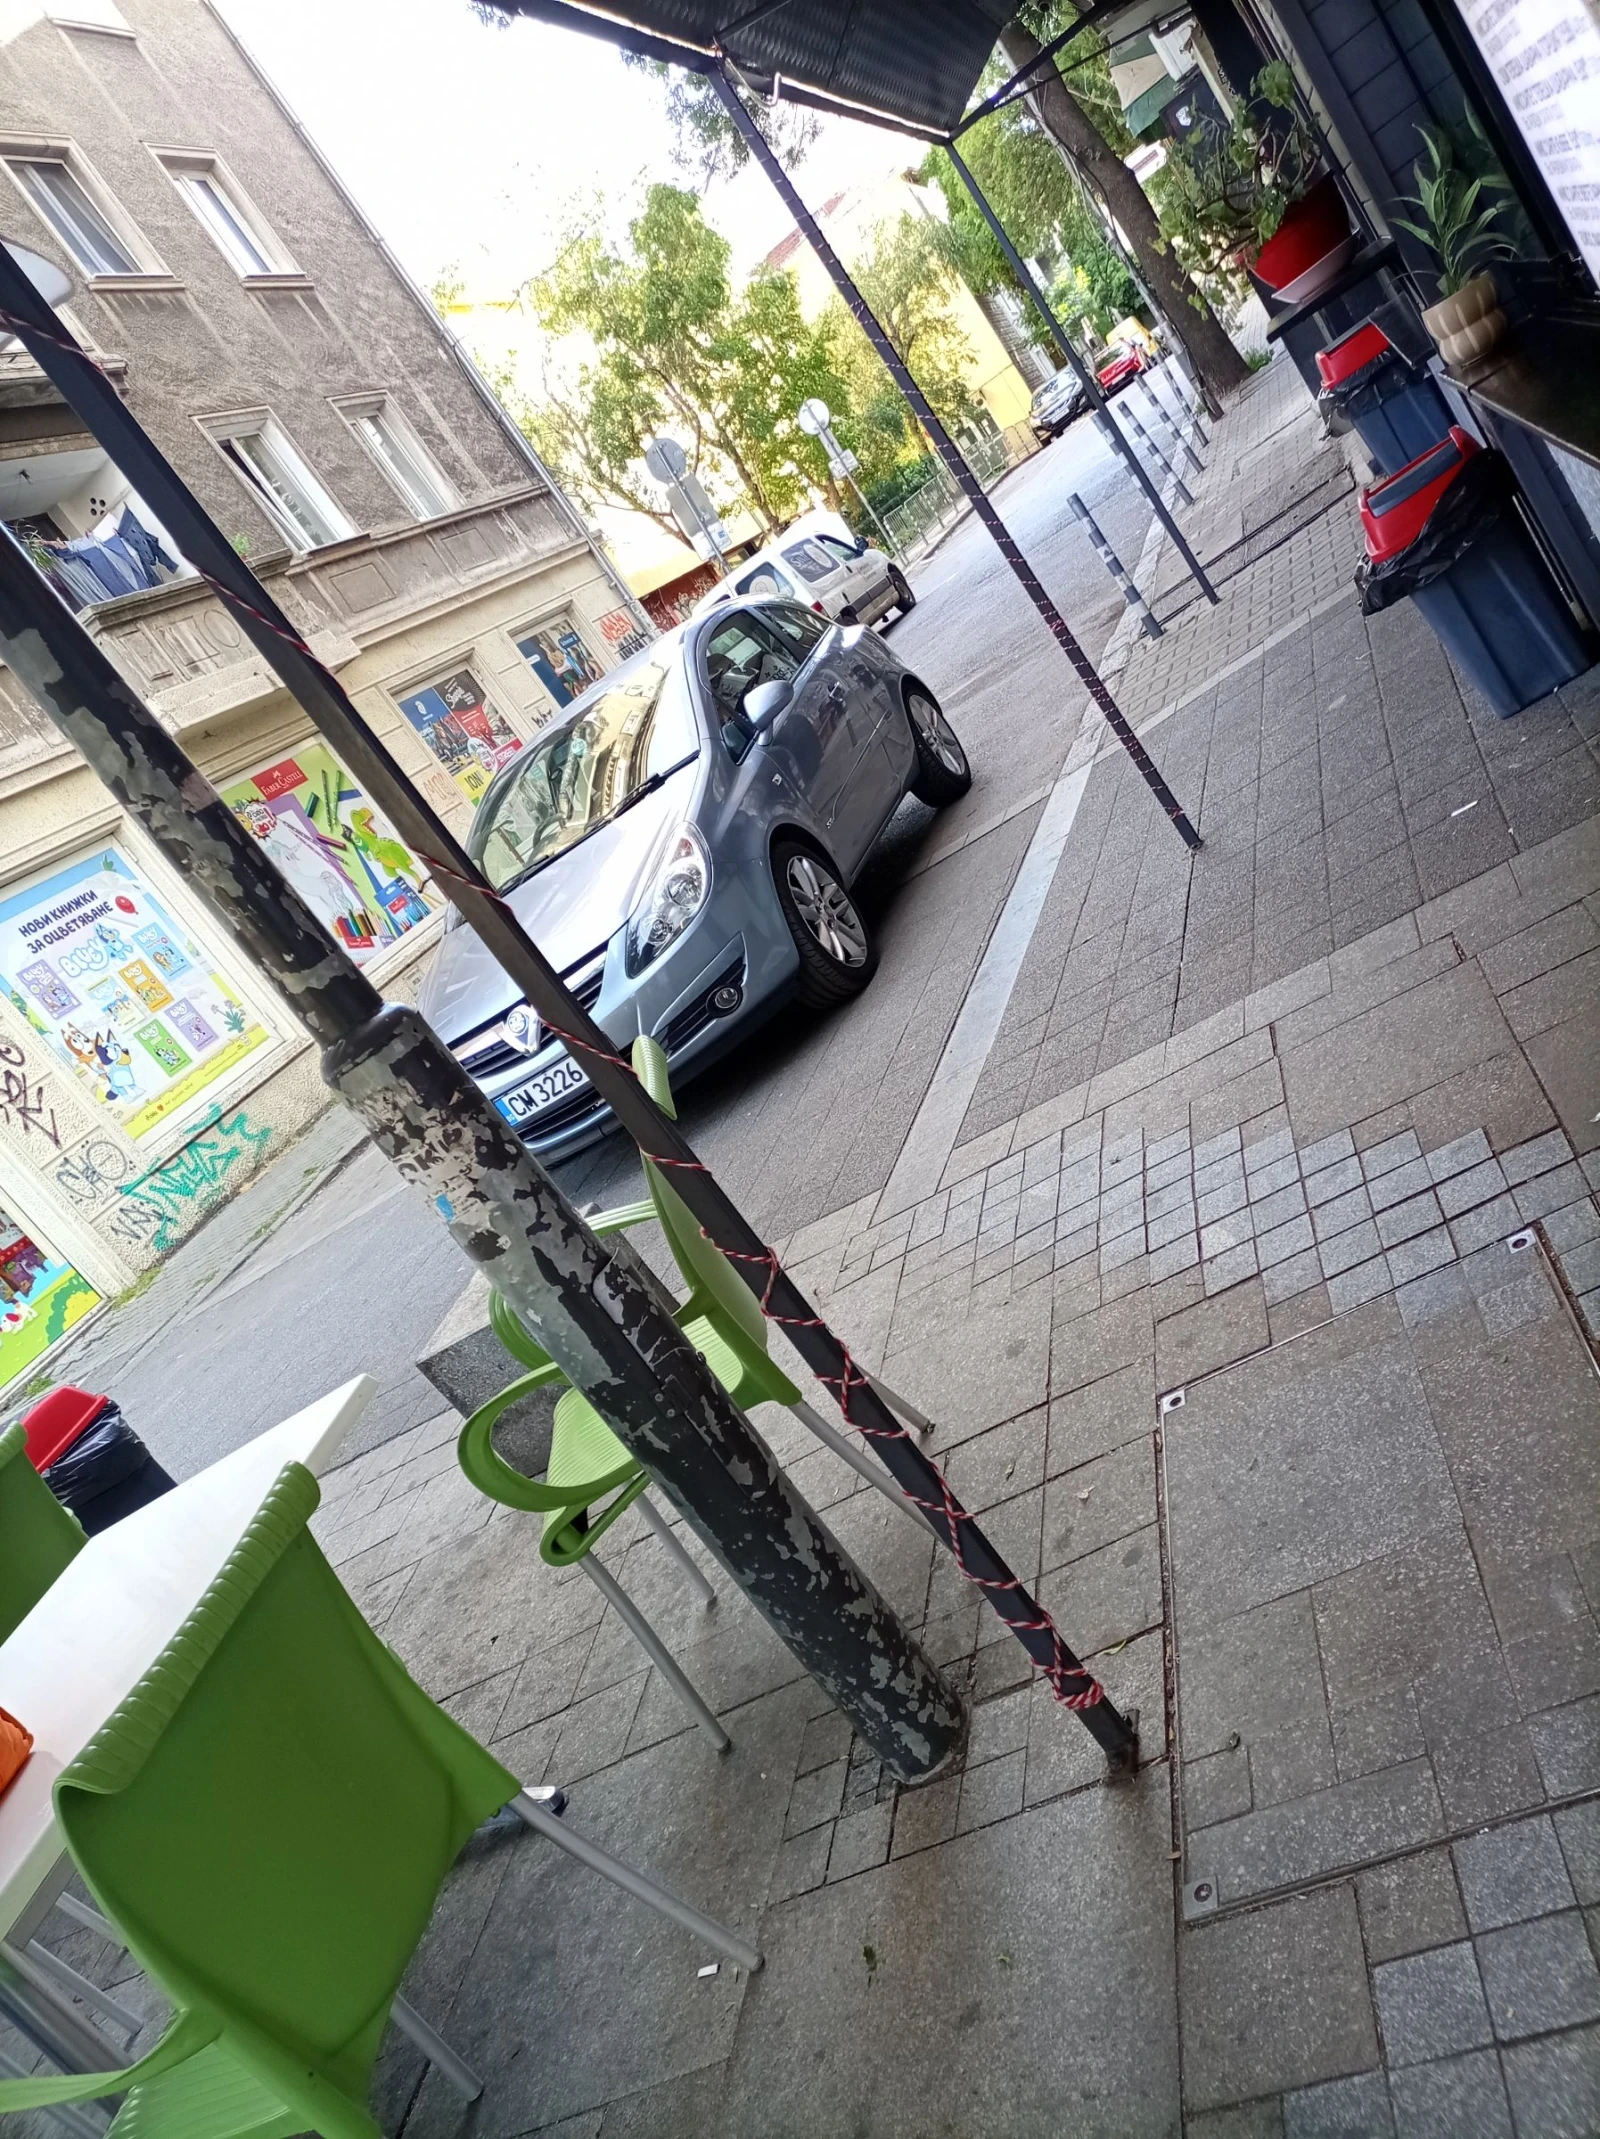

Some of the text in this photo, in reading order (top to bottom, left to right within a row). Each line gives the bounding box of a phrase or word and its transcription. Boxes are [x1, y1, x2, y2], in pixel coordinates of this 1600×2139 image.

[18, 889, 99, 938] НОВИ КНИЖКИ
[27, 901, 114, 954] ЗА ОЦВЕТЯВАНЕ
[508, 1062, 583, 1116] CM 3226
